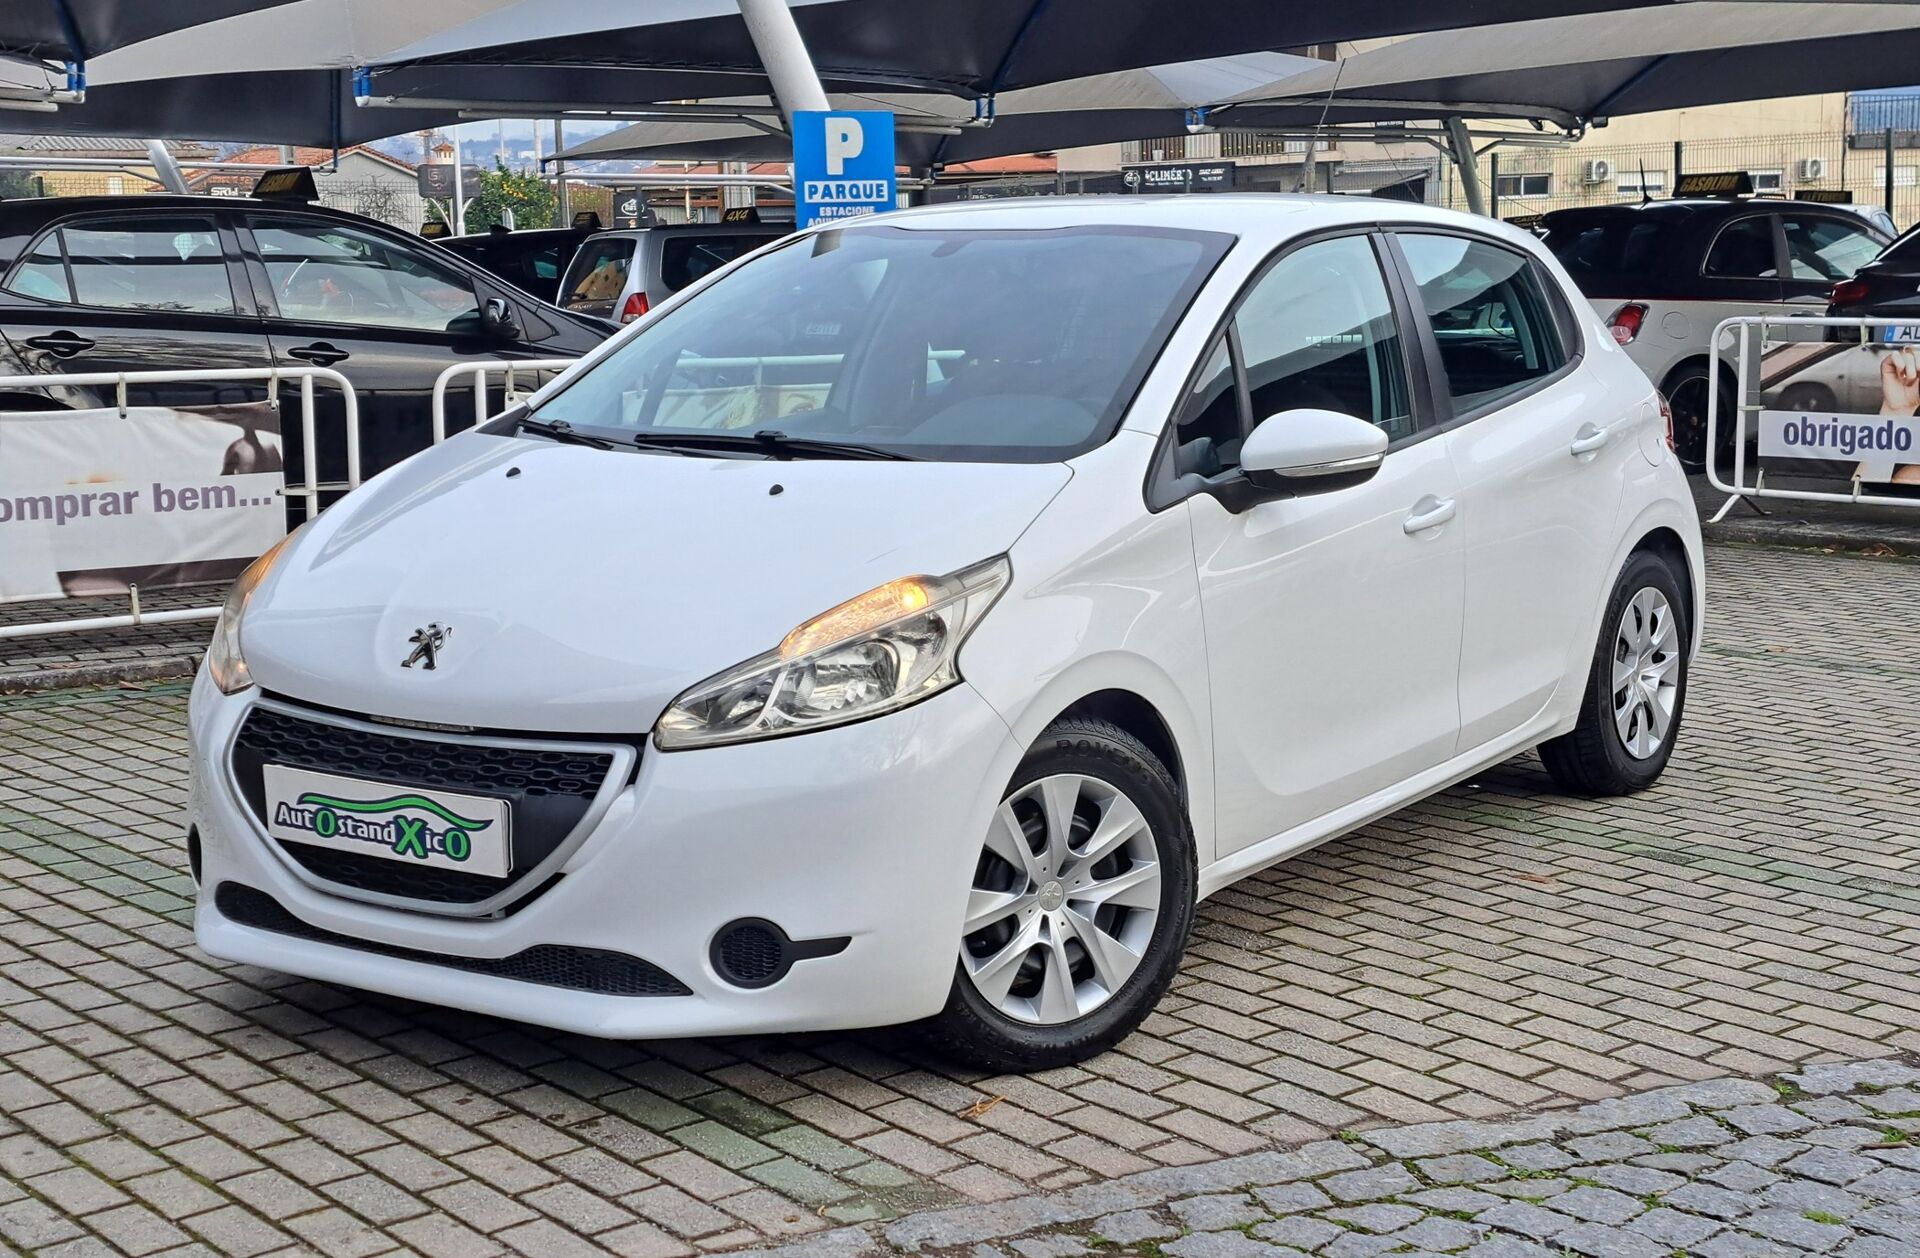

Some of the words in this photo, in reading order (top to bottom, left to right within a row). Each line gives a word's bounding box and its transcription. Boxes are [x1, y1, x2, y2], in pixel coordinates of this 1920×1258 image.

[825, 117, 864, 175] P
[808, 184, 884, 199] PARQUE
[727, 209, 750, 222] 4X4
[820, 206, 874, 216] ESTACIONE
[1783, 416, 1912, 455] obrigado
[152, 483, 272, 513] bem...
